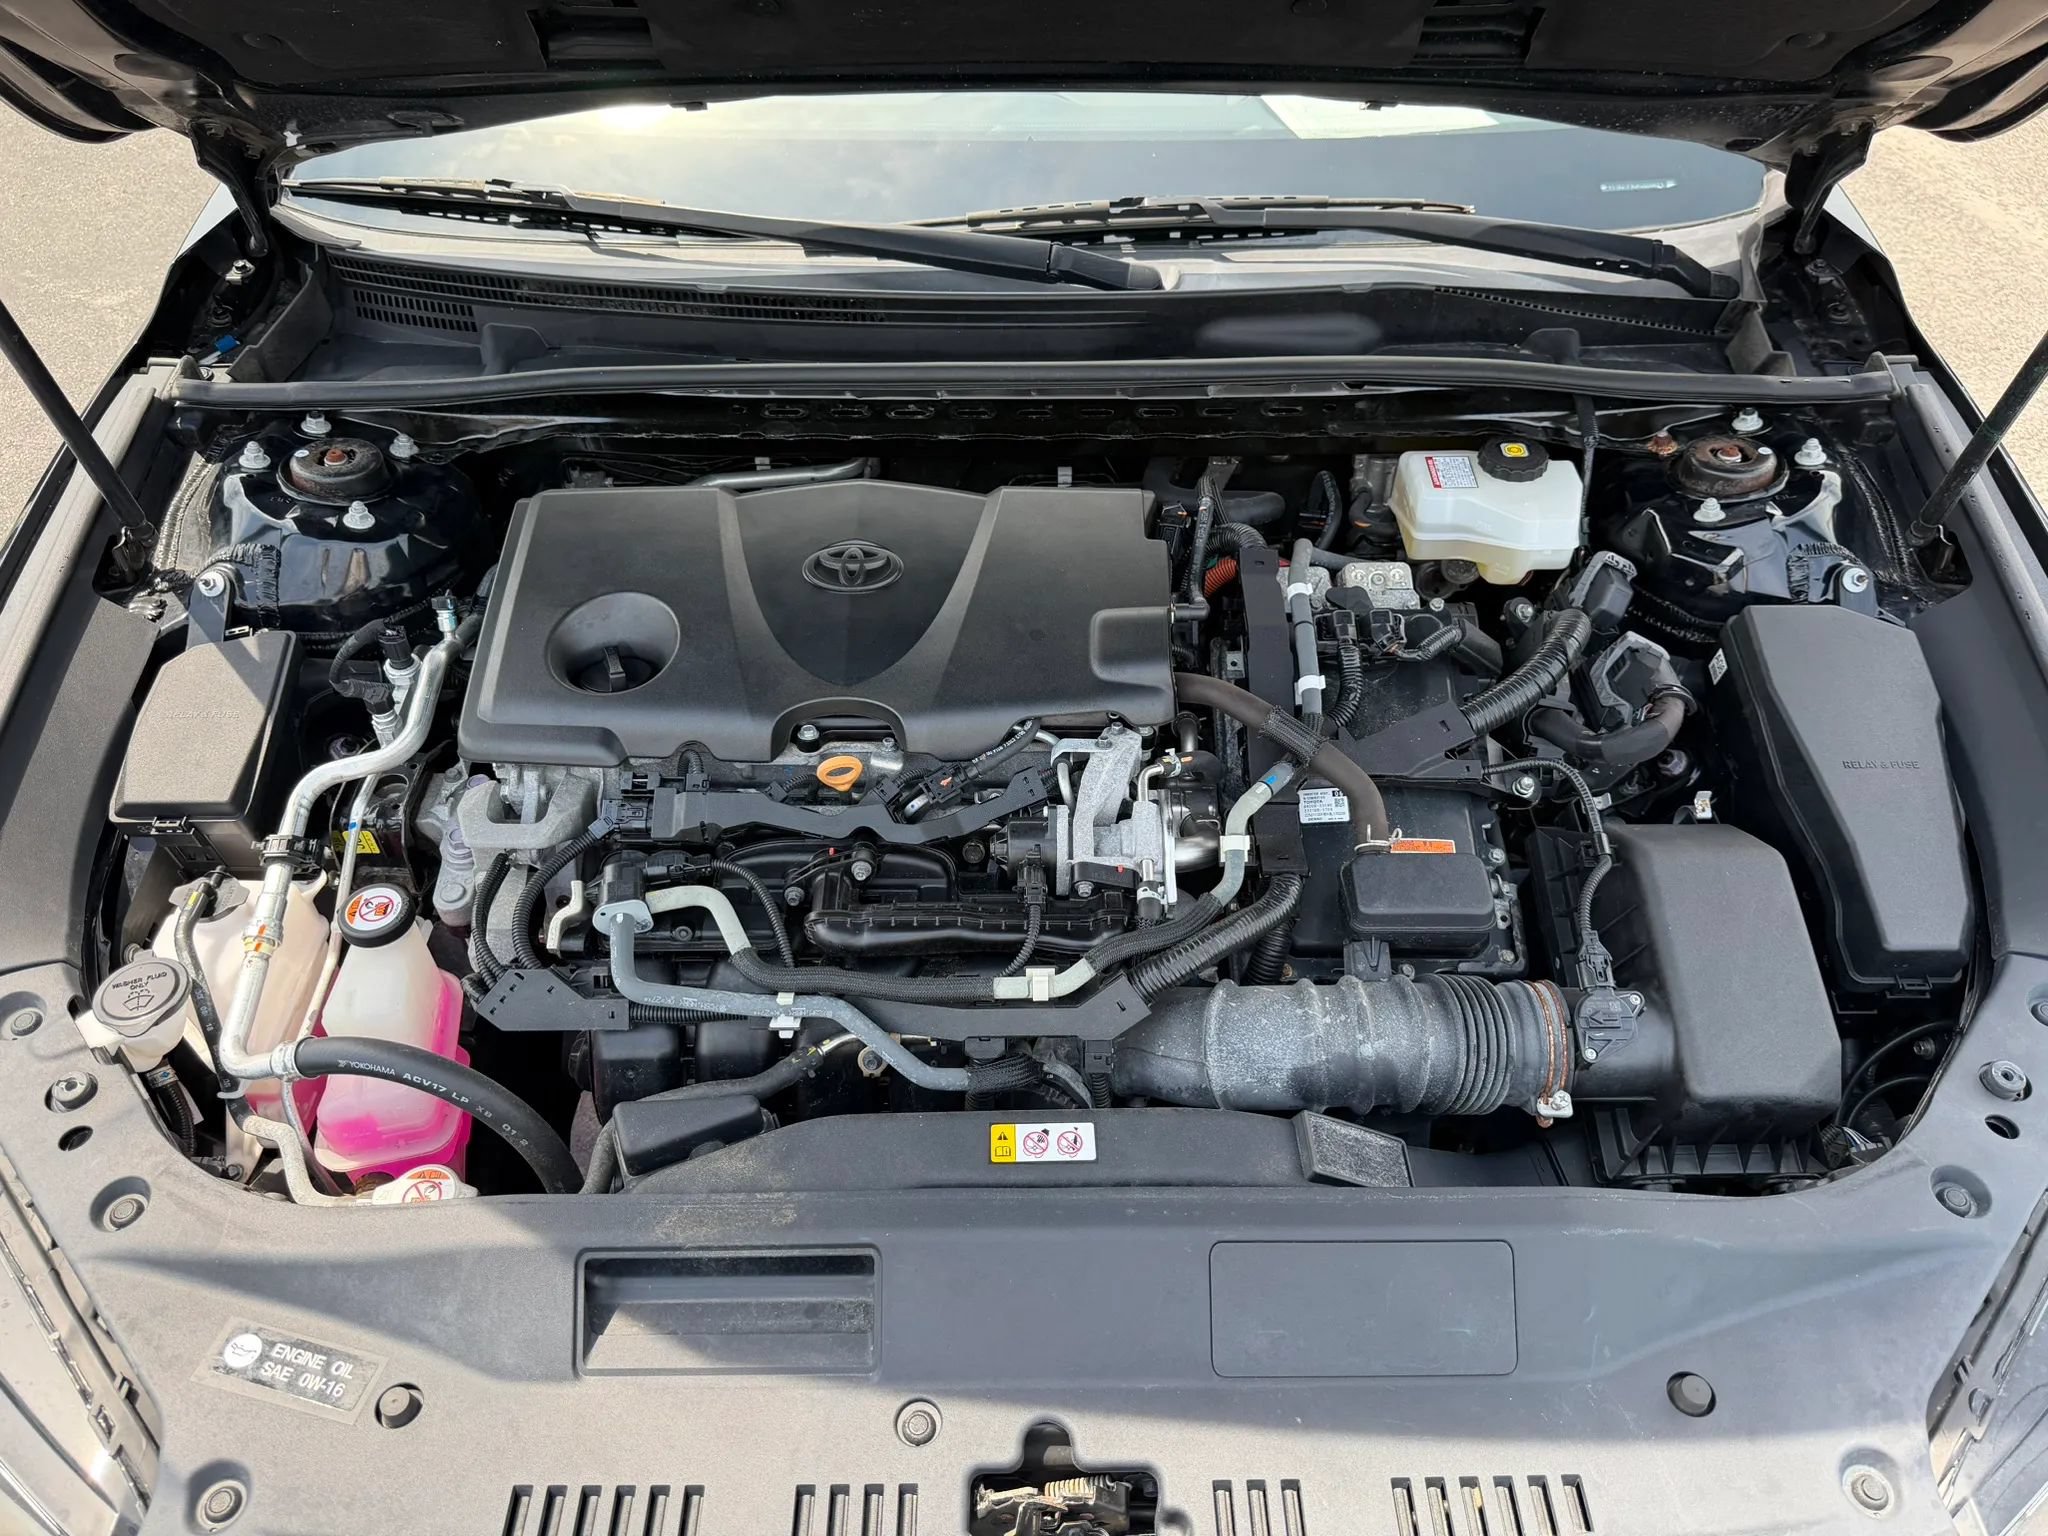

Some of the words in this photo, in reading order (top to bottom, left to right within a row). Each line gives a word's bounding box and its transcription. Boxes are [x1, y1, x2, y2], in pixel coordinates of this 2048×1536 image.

[1842, 760, 1877, 769] RELAY
[1890, 760, 1920, 769] FUSE
[112, 978, 143, 989] WASHER
[146, 971, 168, 981] FLUID
[130, 981, 149, 990] ONLY
[350, 1061, 396, 1076] YOKOHAMA
[402, 1072, 447, 1092] ACV17
[451, 1092, 469, 1104] LP
[271, 1343, 327, 1370] ENGINE
[331, 1360, 354, 1380] OIL
[260, 1360, 295, 1382] SAE
[298, 1373, 346, 1398] 0W-16
